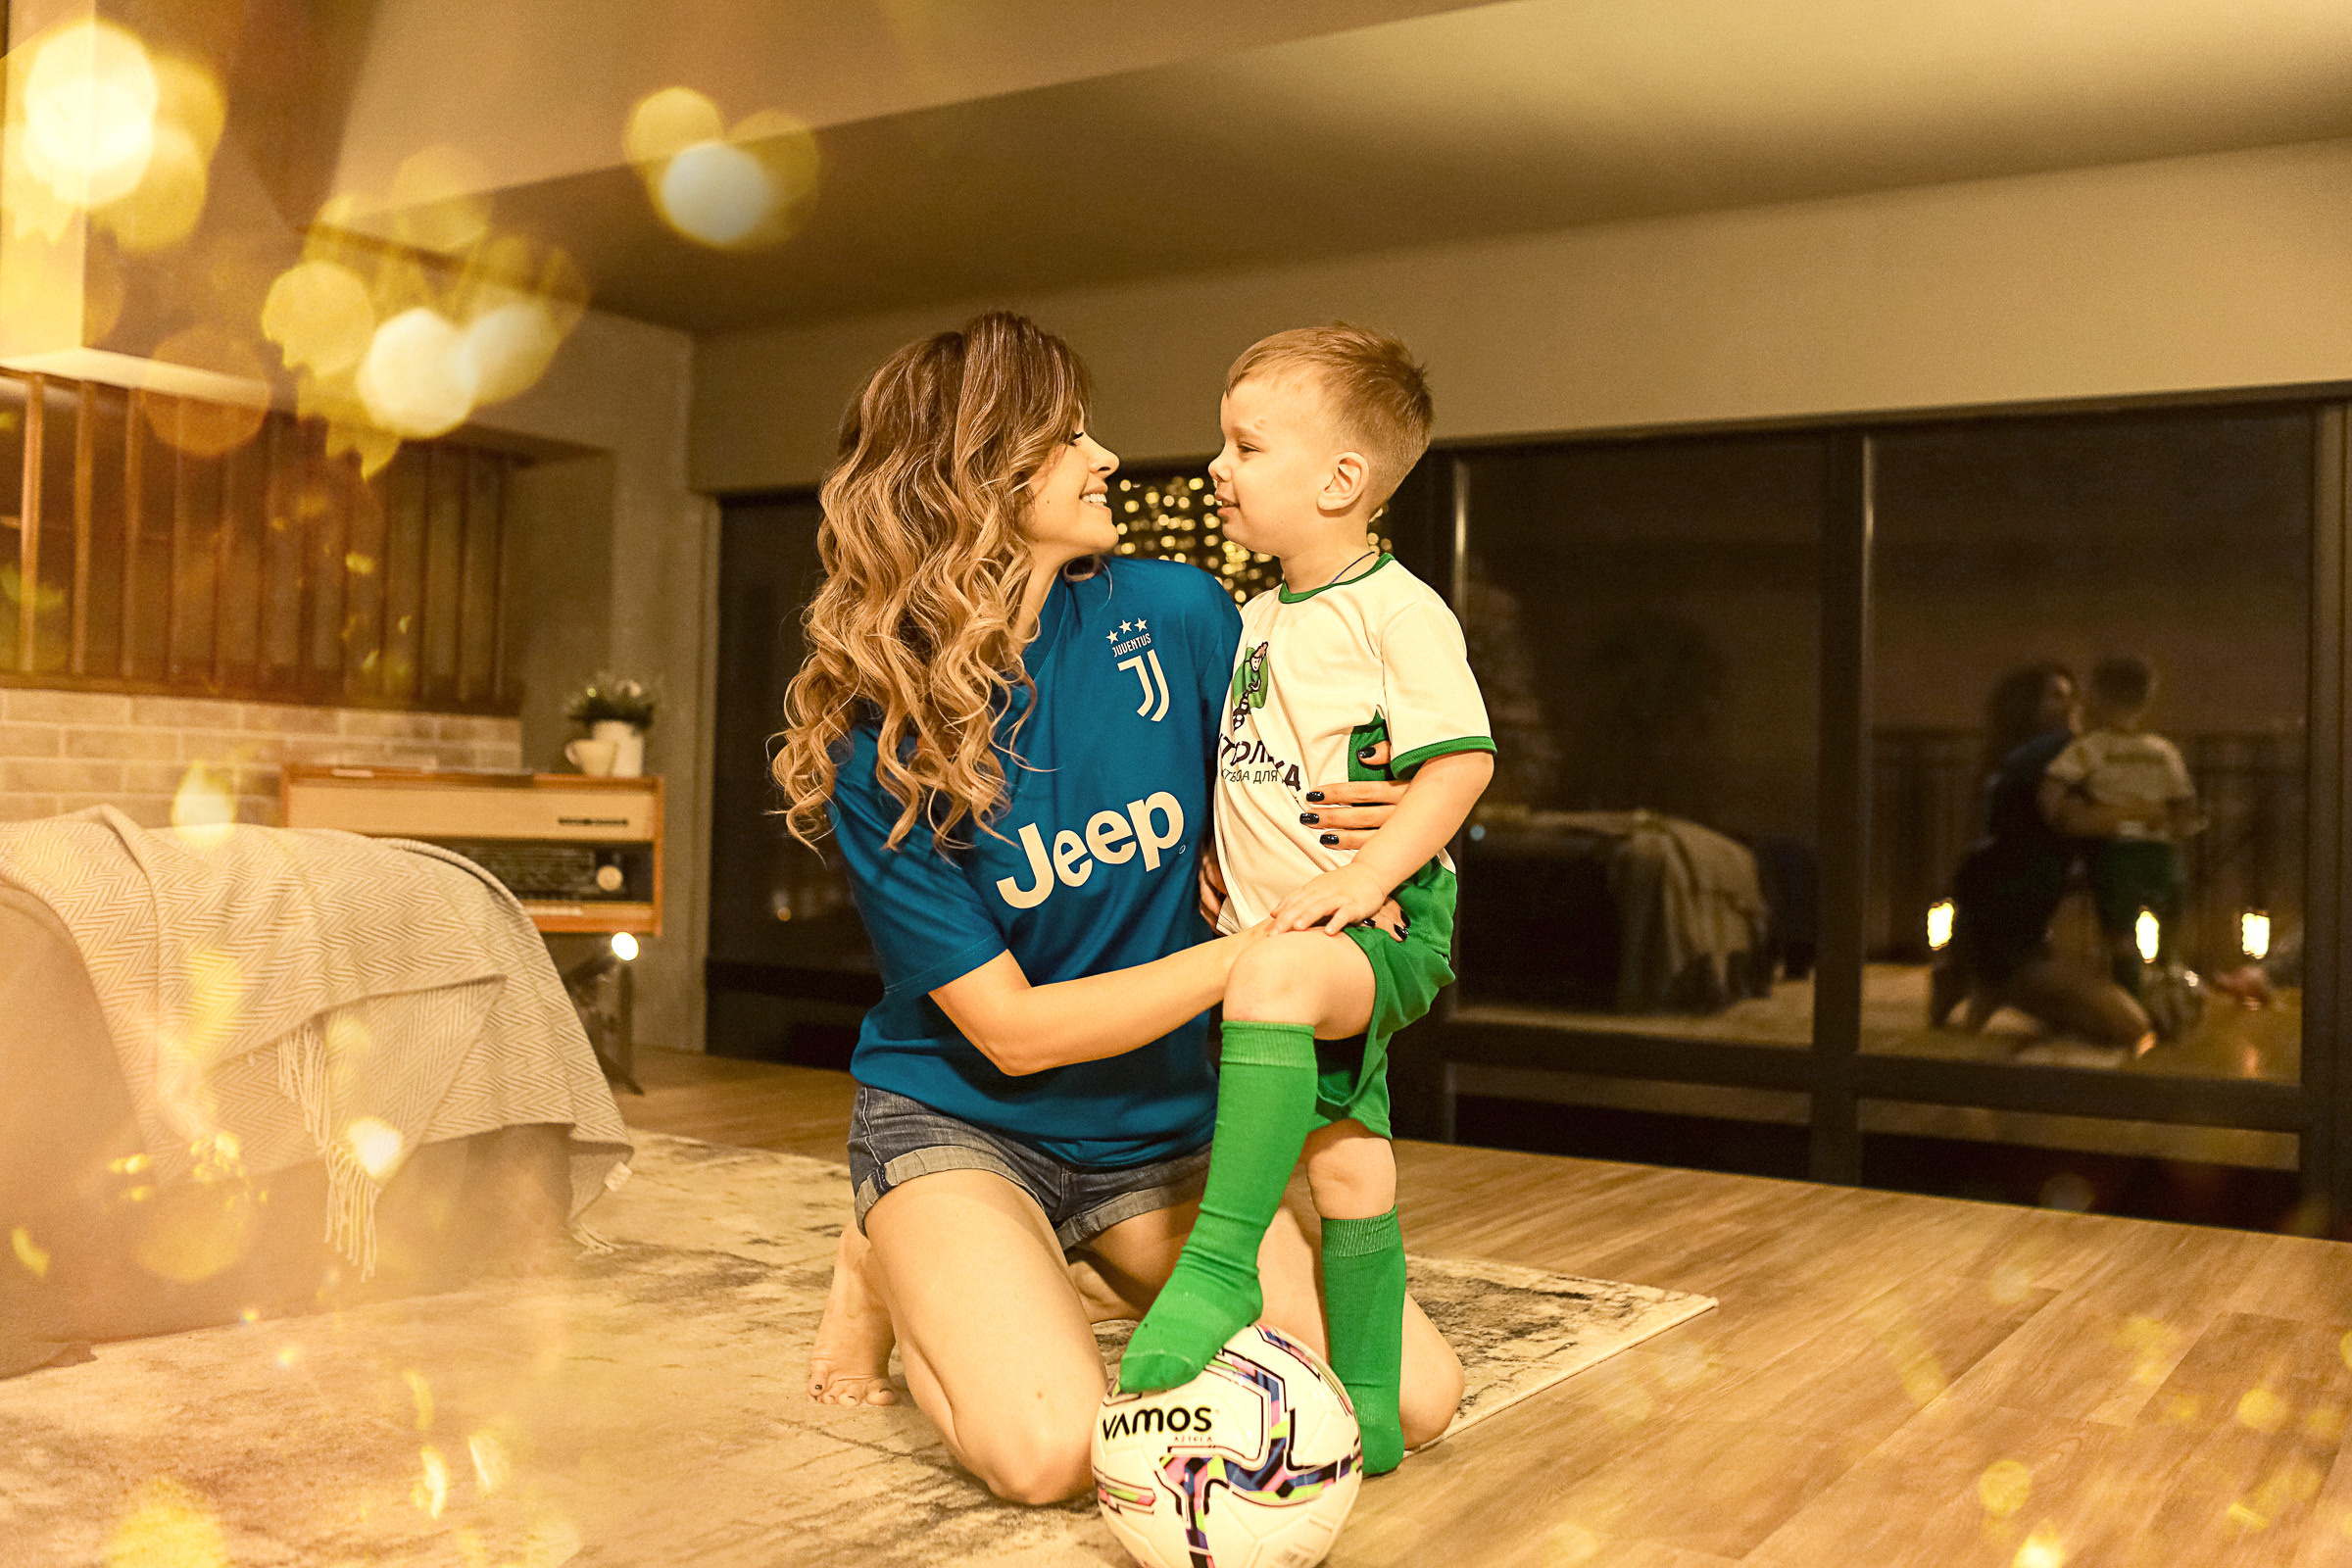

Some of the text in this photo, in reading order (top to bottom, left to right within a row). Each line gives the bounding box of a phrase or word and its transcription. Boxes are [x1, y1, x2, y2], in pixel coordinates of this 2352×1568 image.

[1111, 632, 1152, 658] JUVENTUS
[1252, 769, 1278, 785] ДЛЯ
[996, 791, 1185, 909] Jeep
[1102, 1406, 1212, 1441] VAMOS
